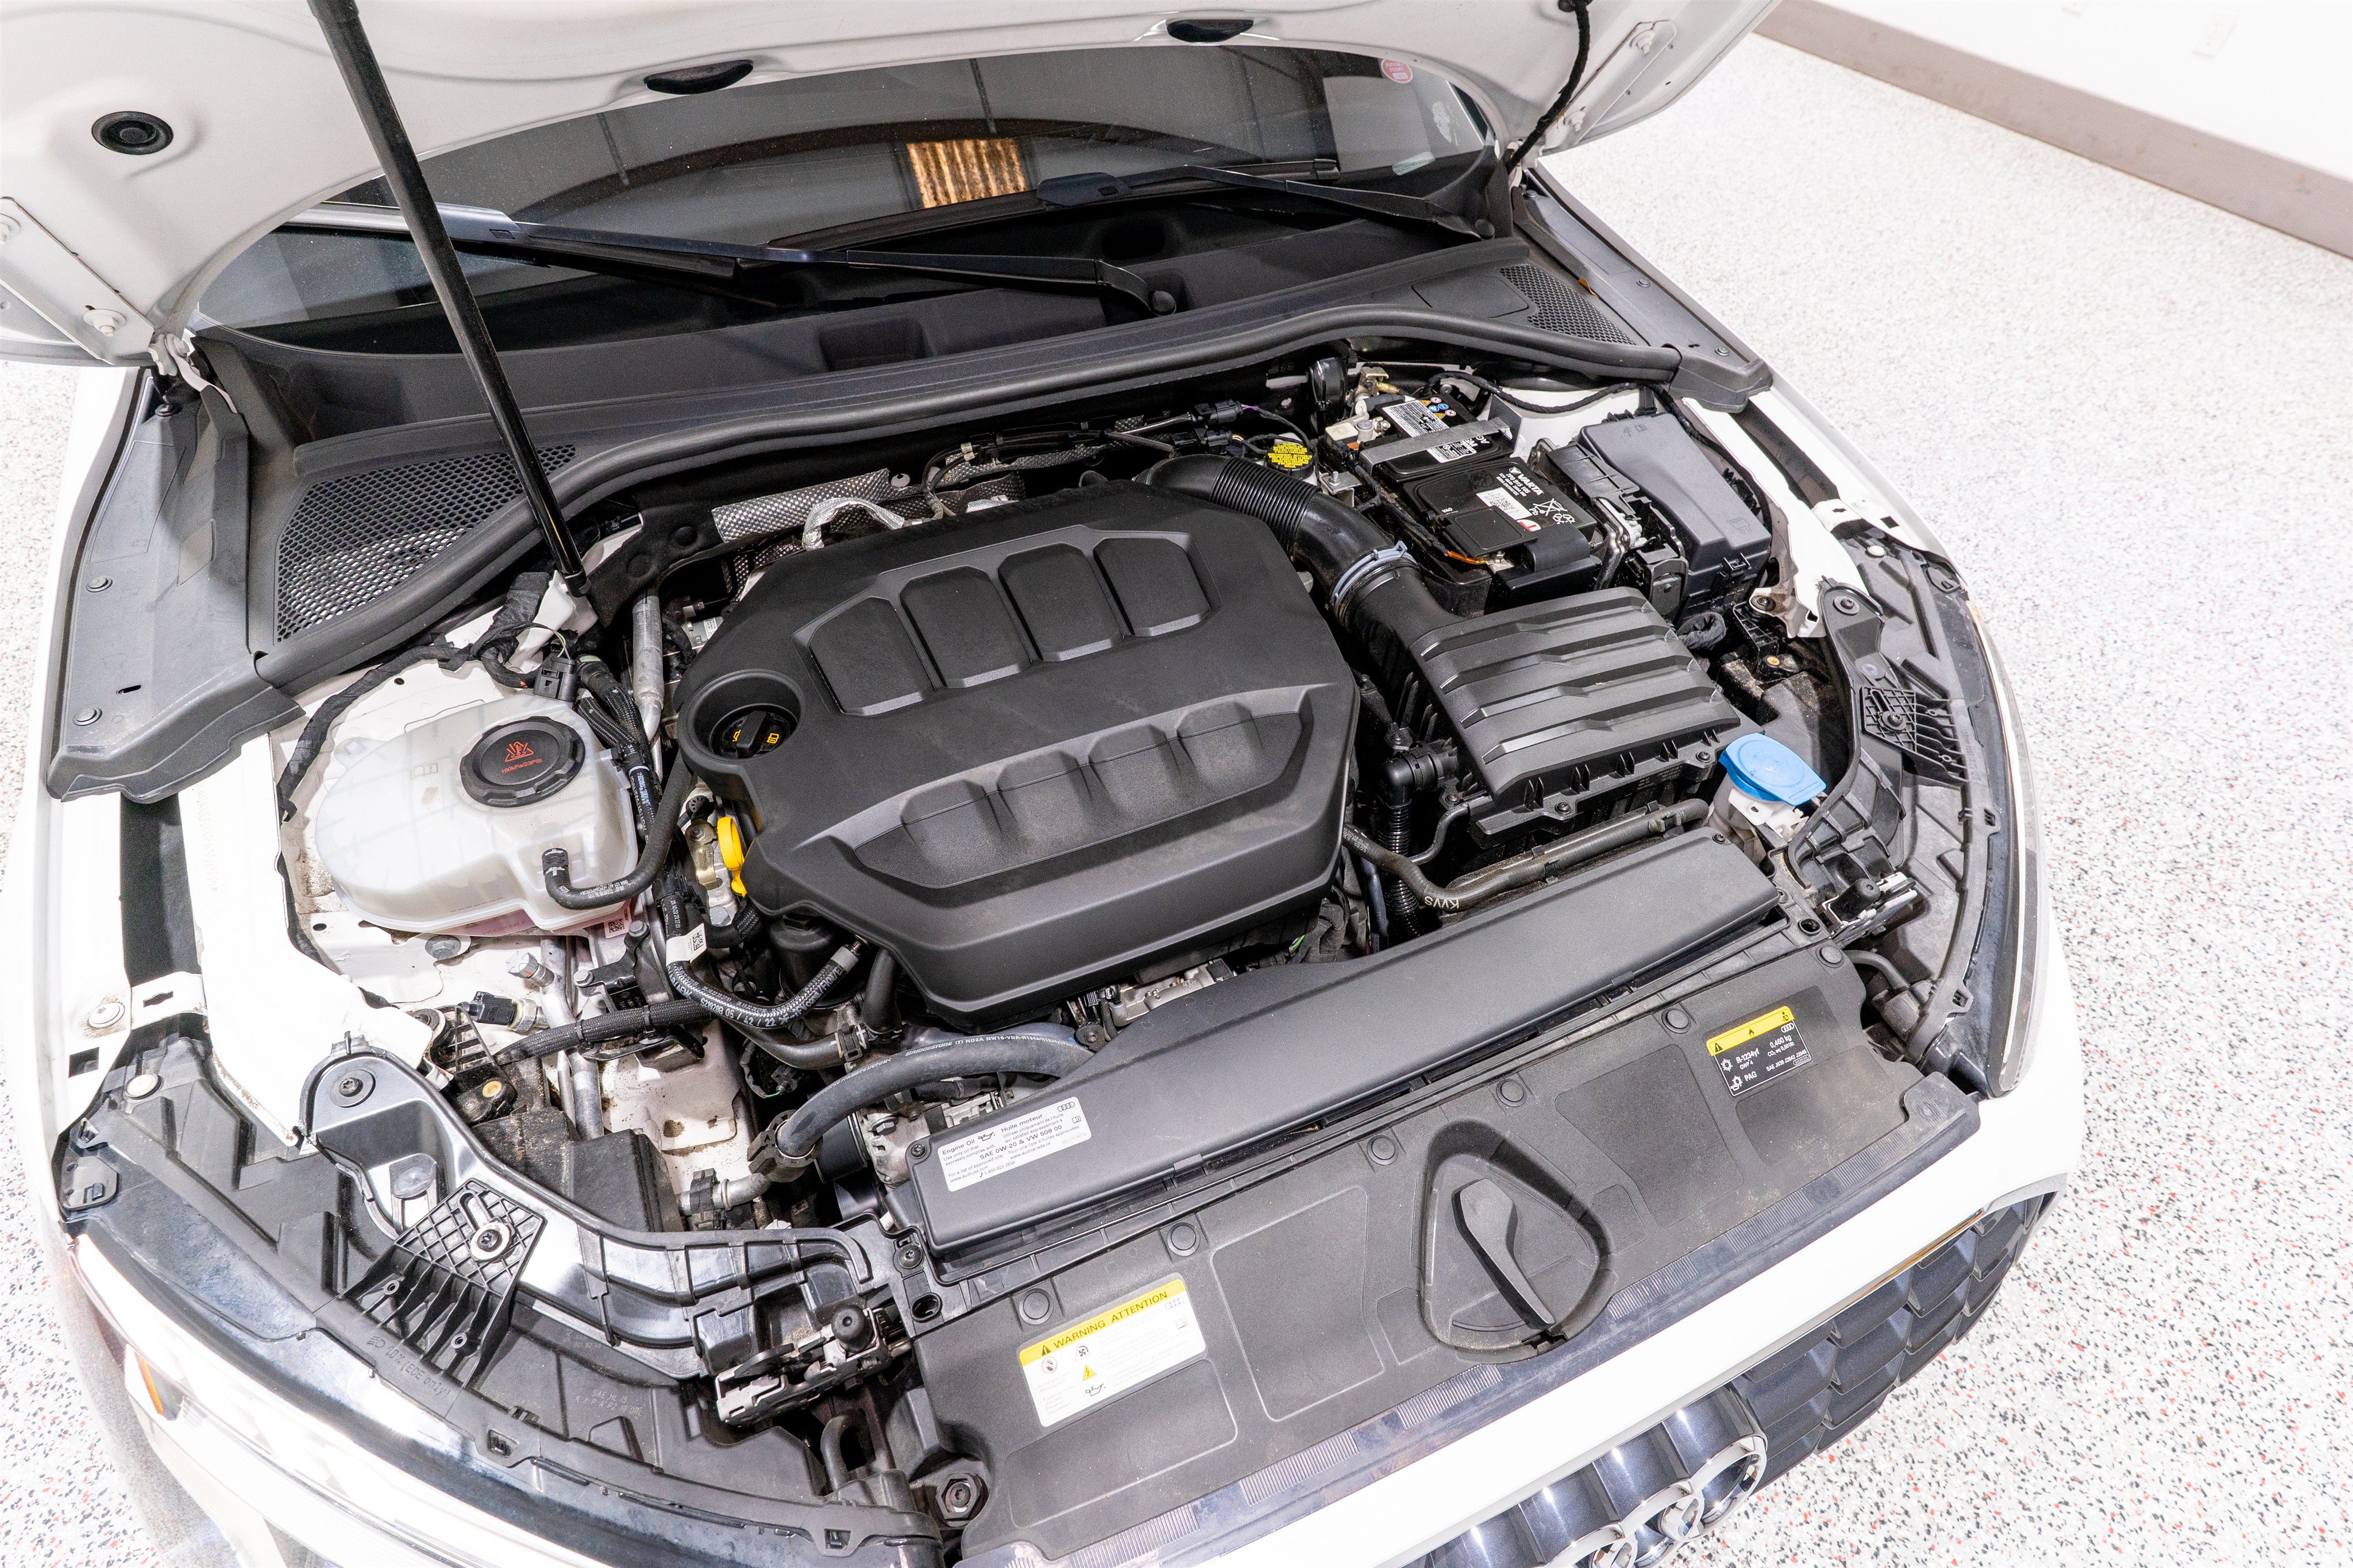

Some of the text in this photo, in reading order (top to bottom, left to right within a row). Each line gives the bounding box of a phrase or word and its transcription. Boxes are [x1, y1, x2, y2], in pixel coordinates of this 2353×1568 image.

[1513, 480, 1523, 488] 915
[1517, 474, 1544, 495] VARTA
[502, 758, 542, 774] 160kPa/23PSI
[725, 1010, 735, 1019] 05
[743, 1015, 754, 1025] 42
[765, 1018, 777, 1027] 22
[905, 1040, 953, 1057] BRIDGESTONE
[965, 1037, 985, 1045] ND2A
[1769, 1033, 1792, 1049] 0,460 kg
[1735, 1048, 1761, 1065] R-1234yf
[1739, 1061, 1750, 1070] GWP
[1765, 1063, 1775, 1072] SAE
[1774, 1059, 1785, 1068] J639
[1743, 1070, 1757, 1082] PAG
[1001, 1113, 1043, 1133] Huile moteur
[1002, 1129, 1019, 1138] Utilisez
[1018, 1119, 1044, 1133] uniquement
[1012, 1130, 1030, 1140] satisfait
[1029, 1119, 1058, 1134] expressément
[942, 1142, 965, 1156] Engine
[979, 1150, 994, 1160] SAE
[994, 1141, 1017, 1153] 0W-20
[1025, 1133, 1039, 1142] VW
[1039, 1128, 1052, 1137] 508
[1053, 1123, 1063, 1131] 00
[944, 1155, 966, 1167] expressly
[965, 1148, 985, 1158] complies
[1009, 1141, 1051, 1160] www.audicanada.ca
[973, 1157, 994, 1169] approved
[983, 1160, 1016, 1175] 1-800-822-2834
[949, 1164, 989, 1183] www.audiusa.com
[1052, 1319, 1106, 1349] WARNING
[1109, 1290, 1168, 1323] ATTENTION
[400, 1358, 425, 1381] (ECE
[591, 1389, 606, 1399] SAE
